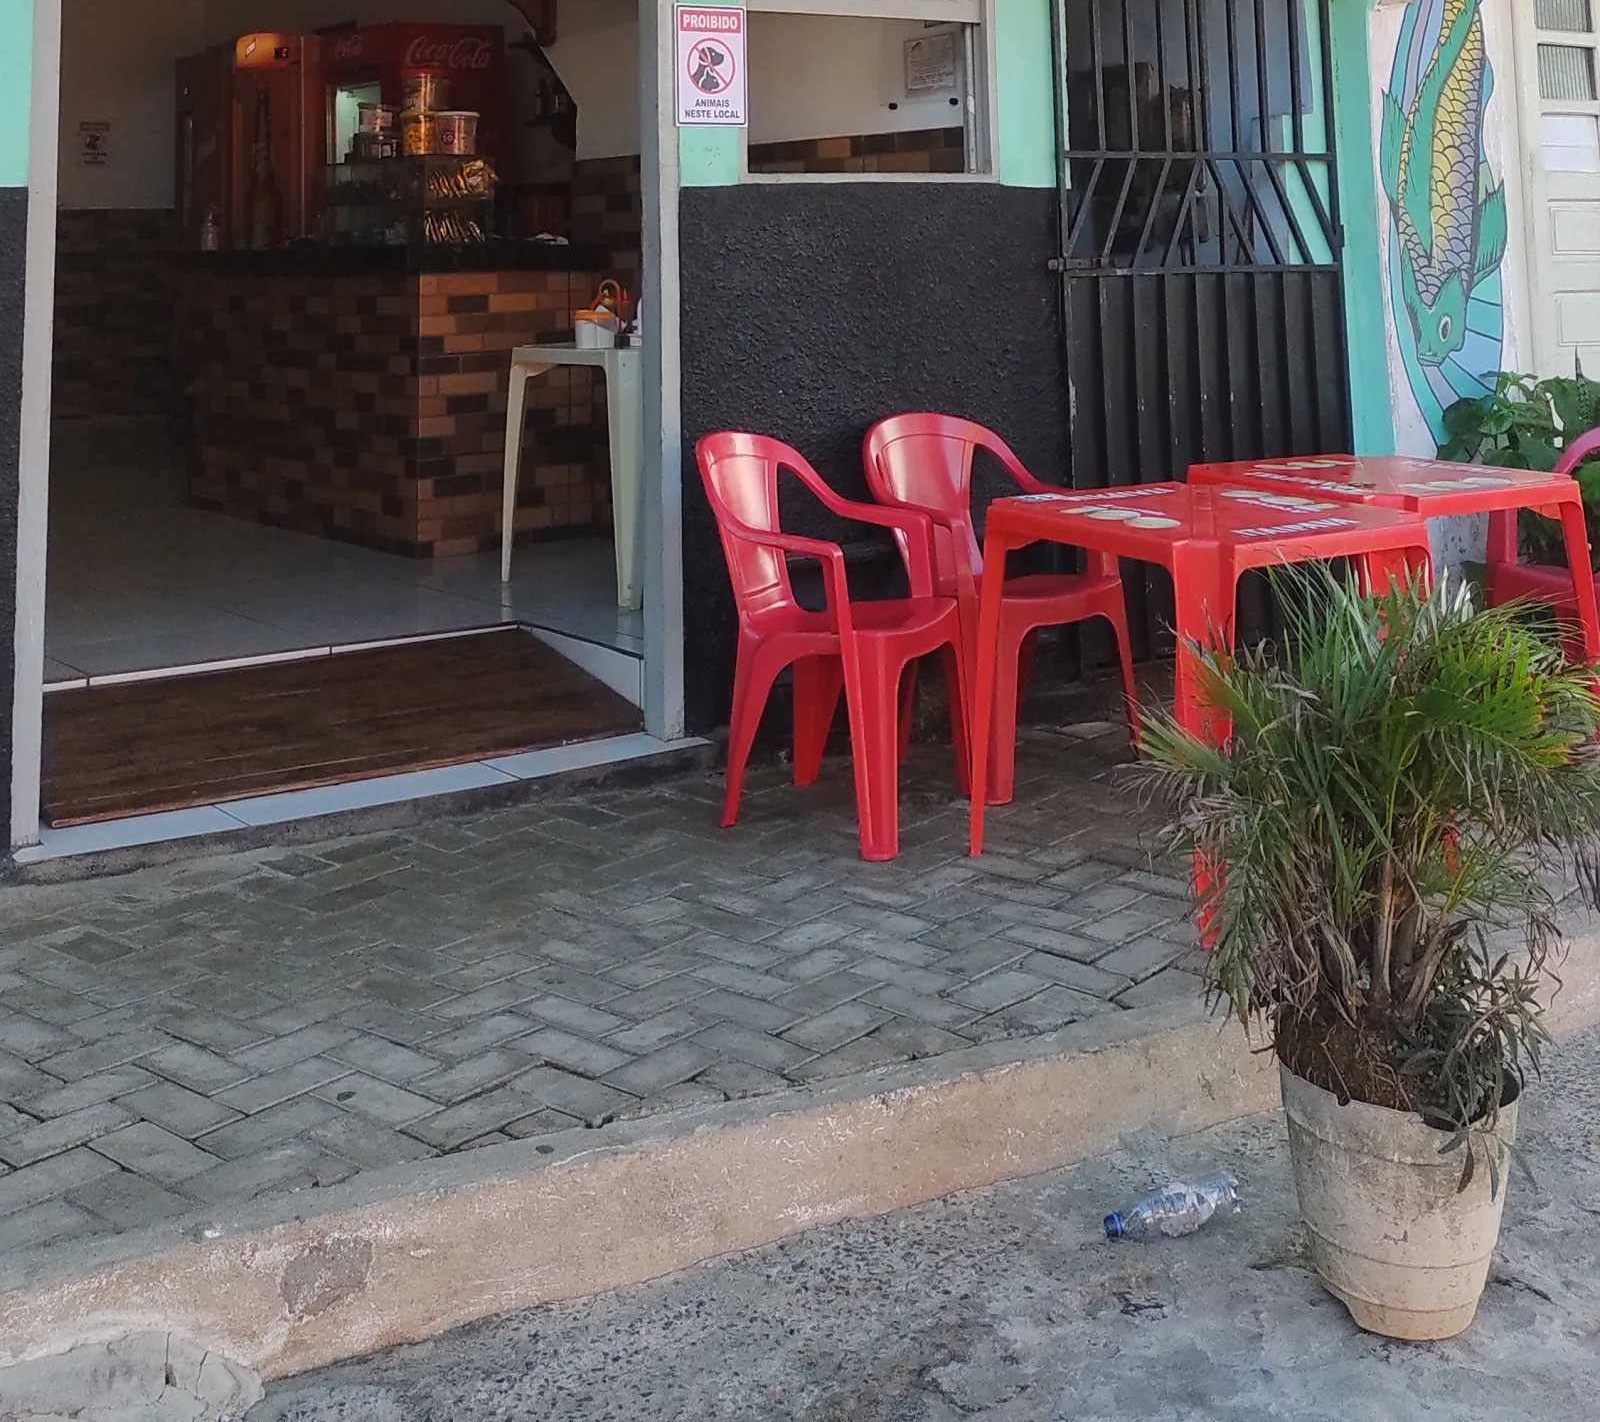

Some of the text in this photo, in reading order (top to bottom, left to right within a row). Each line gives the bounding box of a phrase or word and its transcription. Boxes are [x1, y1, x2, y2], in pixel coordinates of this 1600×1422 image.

[683, 13, 738, 30] PROIBIDO
[695, 98, 730, 108] ANIMAIS
[684, 109, 741, 119] NESTE LOCAL
[1231, 517, 1361, 536] ITAIPAVA
